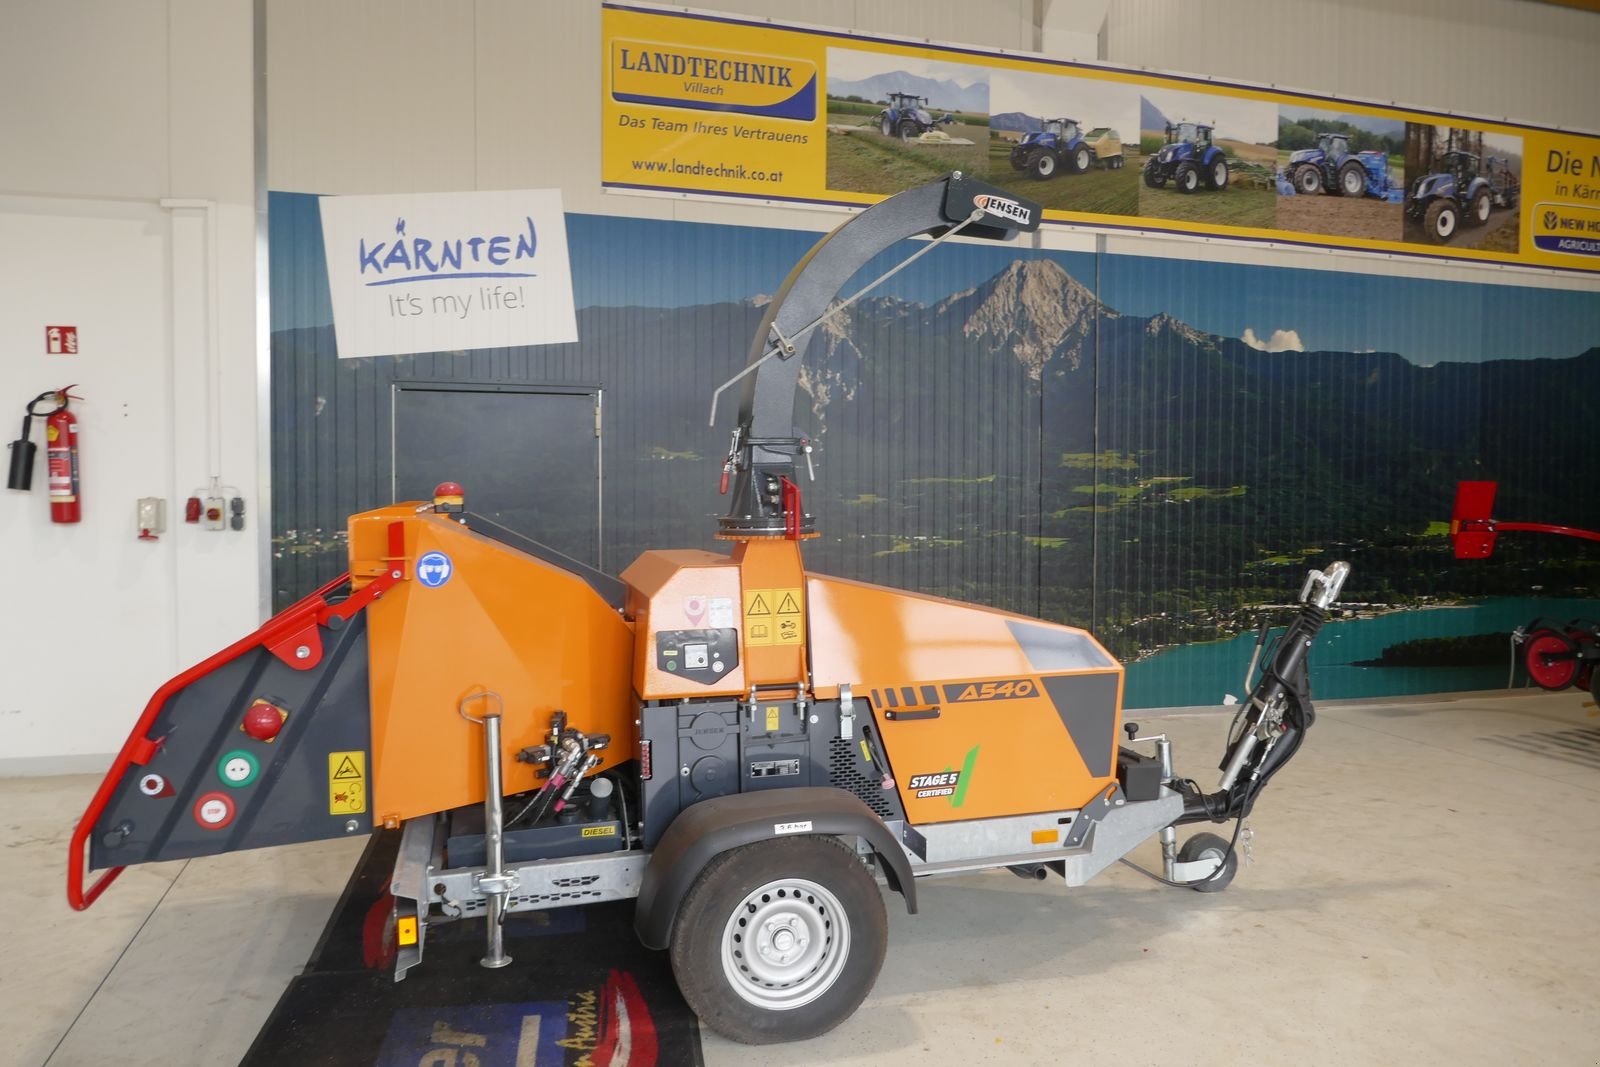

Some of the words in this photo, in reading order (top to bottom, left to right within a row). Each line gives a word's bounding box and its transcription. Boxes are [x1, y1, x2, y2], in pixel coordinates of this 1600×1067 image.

[620, 48, 793, 88] LANDTECHNIK
[683, 81, 724, 96] Villach
[618, 114, 646, 129] Das
[651, 117, 688, 133] Team
[693, 120, 728, 136] Ihres
[733, 125, 809, 145] Vertrauens
[632, 158, 783, 183] www.landtechnik.co.at
[1546, 150, 1583, 176] Die
[1555, 181, 1568, 197] in
[983, 196, 1029, 220] JENSEN
[1560, 218, 1585, 231] NEW
[359, 216, 537, 274] KÄRNTEN
[431, 294, 473, 319] my
[480, 286, 525, 311] life!
[957, 681, 1033, 701] A540
[910, 774, 949, 788] STAGE
[948, 773, 958, 785] 5
[917, 788, 953, 798] CERTIFIED
[583, 827, 614, 836] DIESEL
